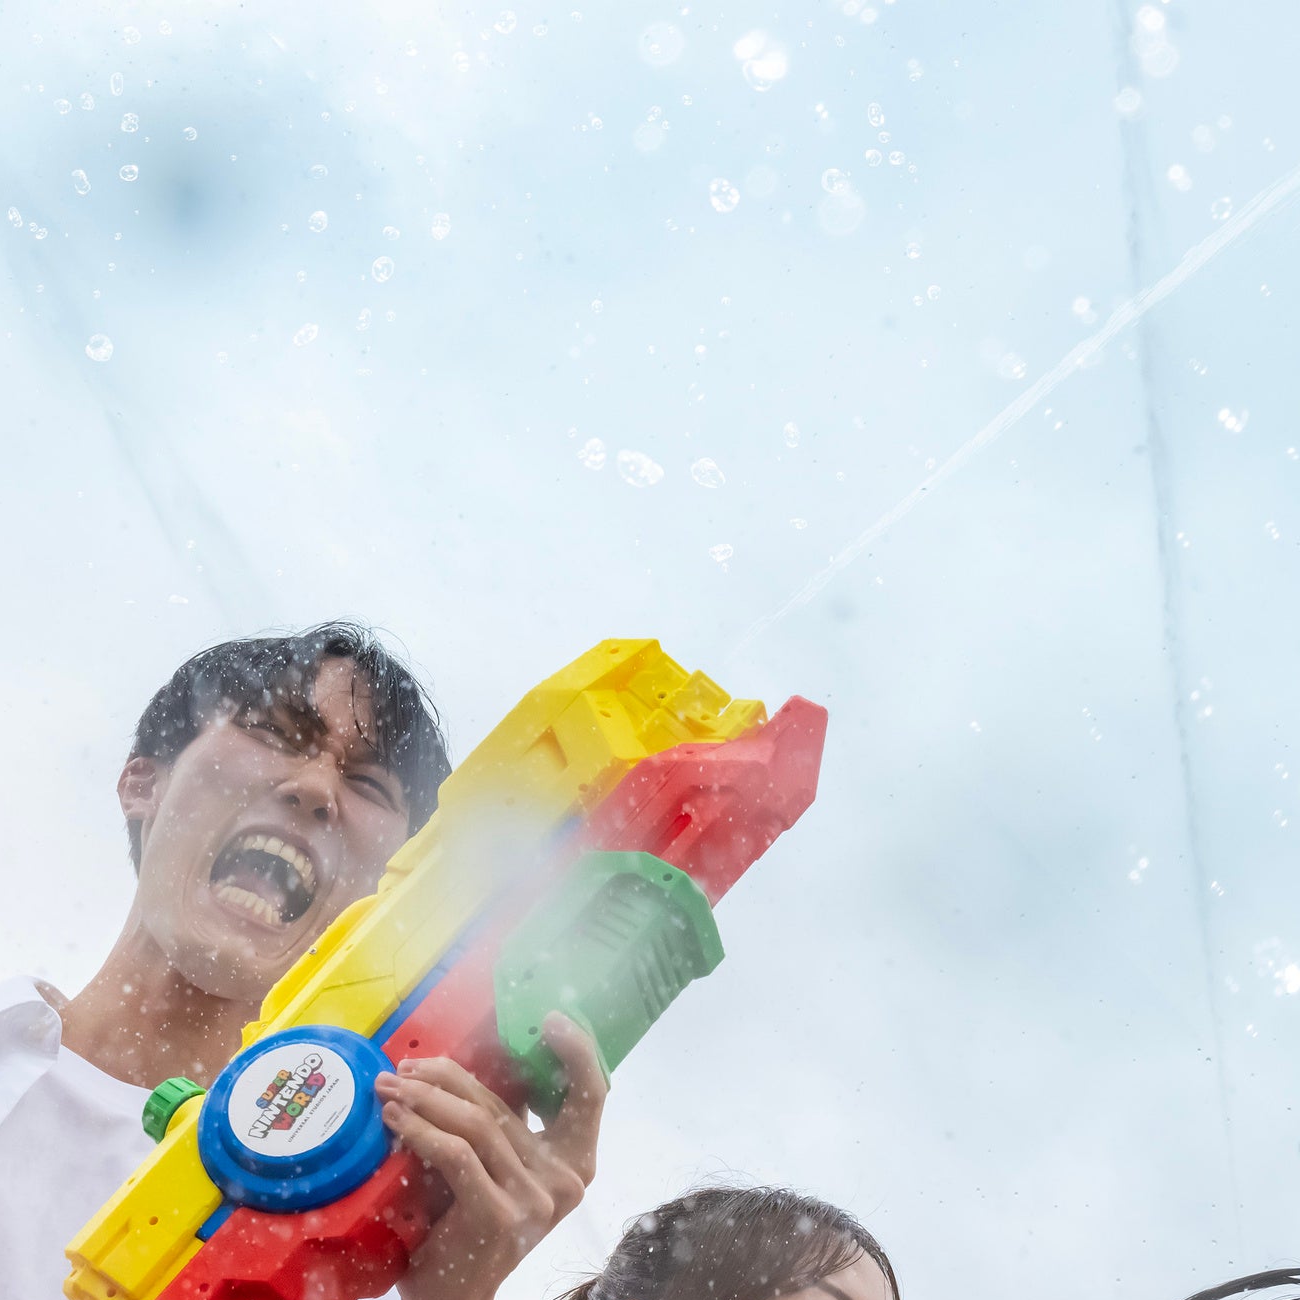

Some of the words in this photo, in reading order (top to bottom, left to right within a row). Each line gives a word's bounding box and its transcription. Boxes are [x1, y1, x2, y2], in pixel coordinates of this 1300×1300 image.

[248, 1053, 323, 1139] NINTENDO
[256, 1069, 292, 1109] SUPER
[272, 1072, 326, 1130] WORLD
